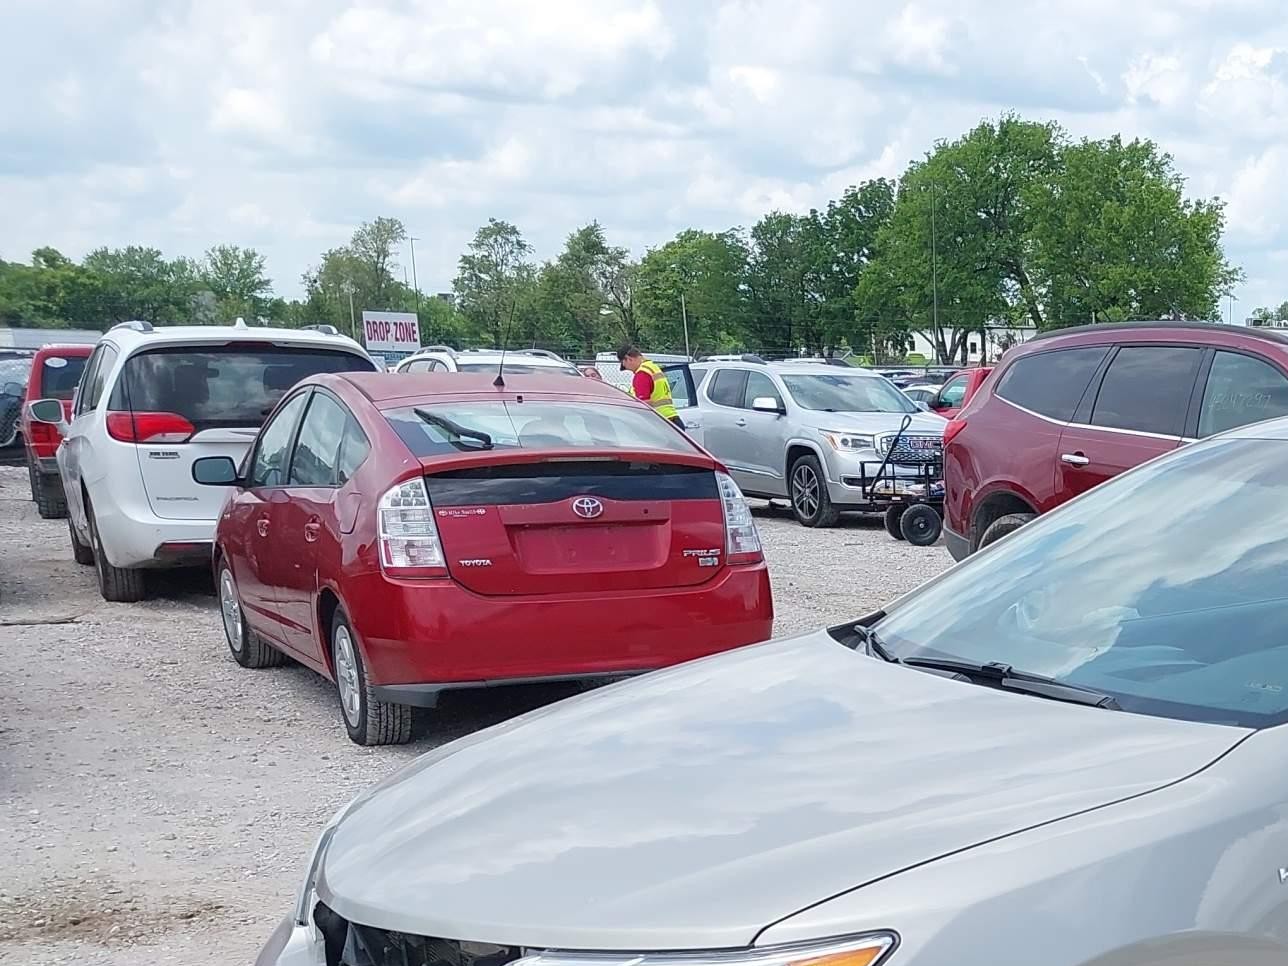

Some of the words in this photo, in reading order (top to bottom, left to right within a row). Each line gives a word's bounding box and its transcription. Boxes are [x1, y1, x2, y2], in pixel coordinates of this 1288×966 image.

[366, 320, 390, 342] DROP
[393, 321, 418, 343] ZONE
[683, 548, 721, 557] PRIUS
[459, 559, 492, 567] TOYOTA
